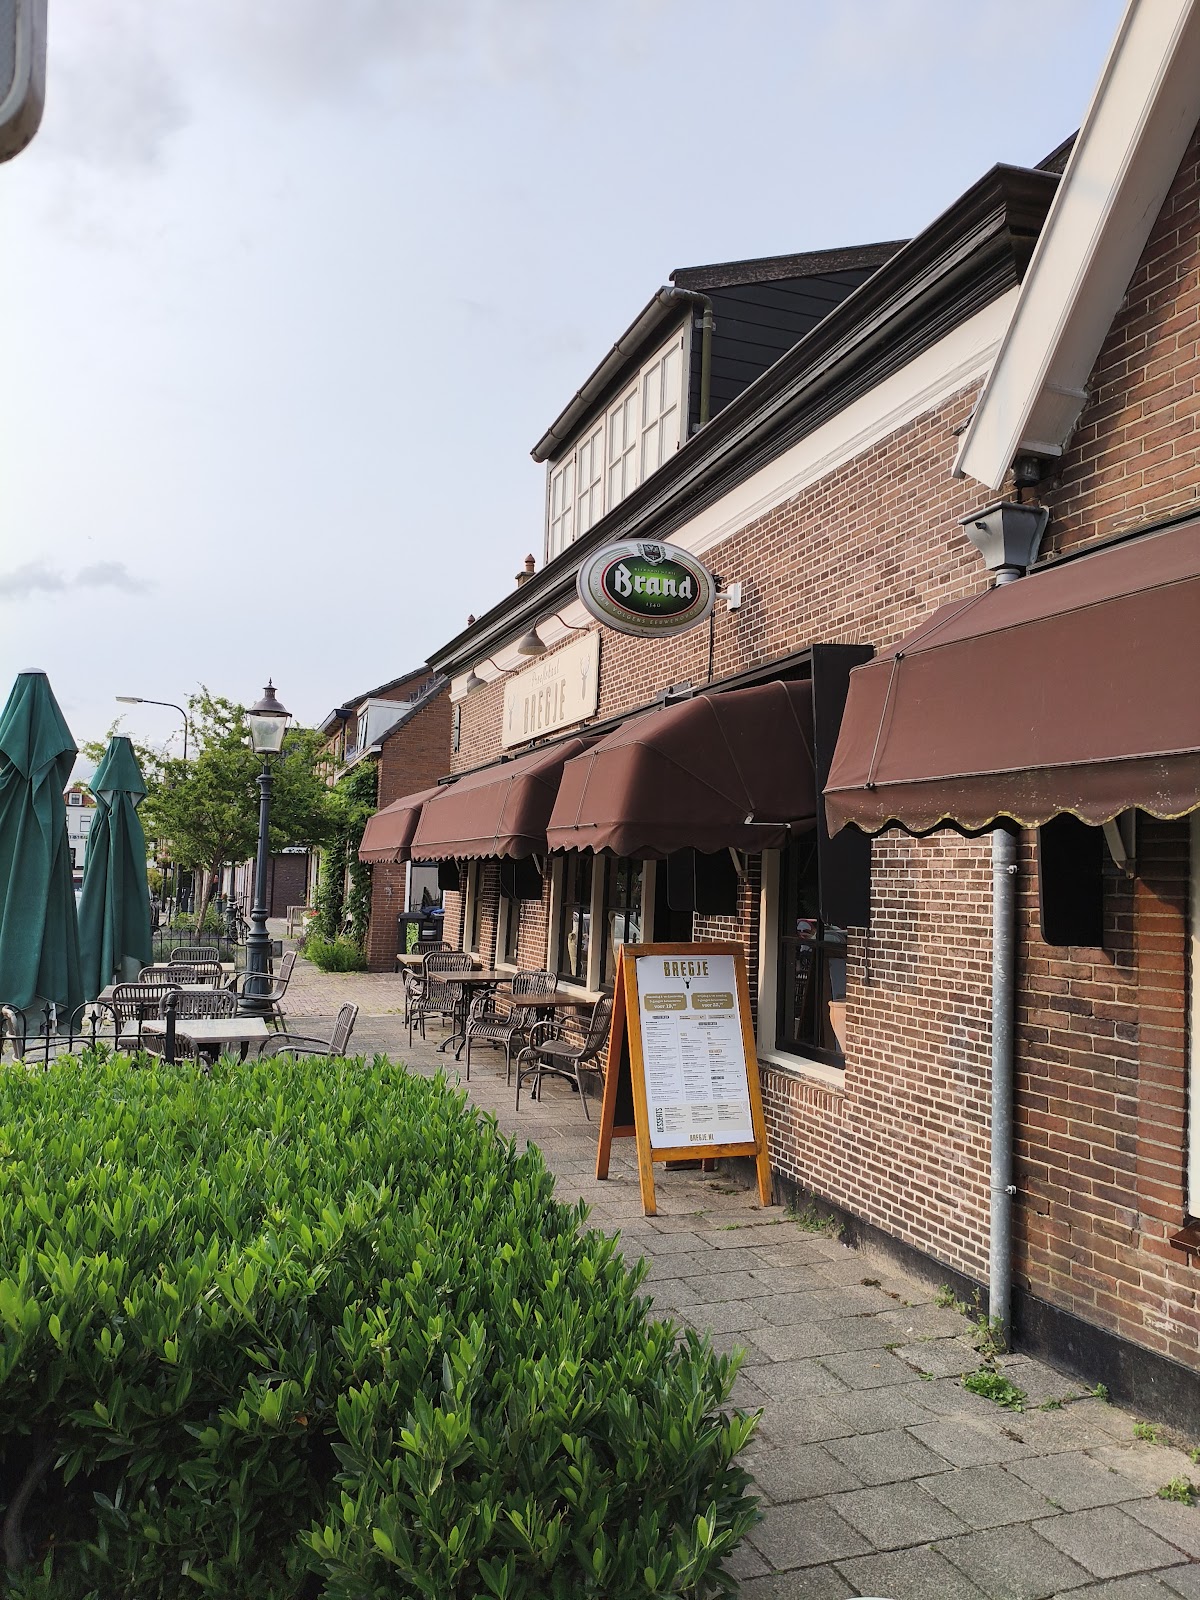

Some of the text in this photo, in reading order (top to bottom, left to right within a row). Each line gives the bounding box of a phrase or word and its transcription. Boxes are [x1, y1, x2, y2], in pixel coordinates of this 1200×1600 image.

[614, 563, 693, 600] Brand
[612, 607, 646, 624] VOLGENS
[663, 961, 709, 976] BREGJE
[655, 1107, 665, 1133] DESSERTS
